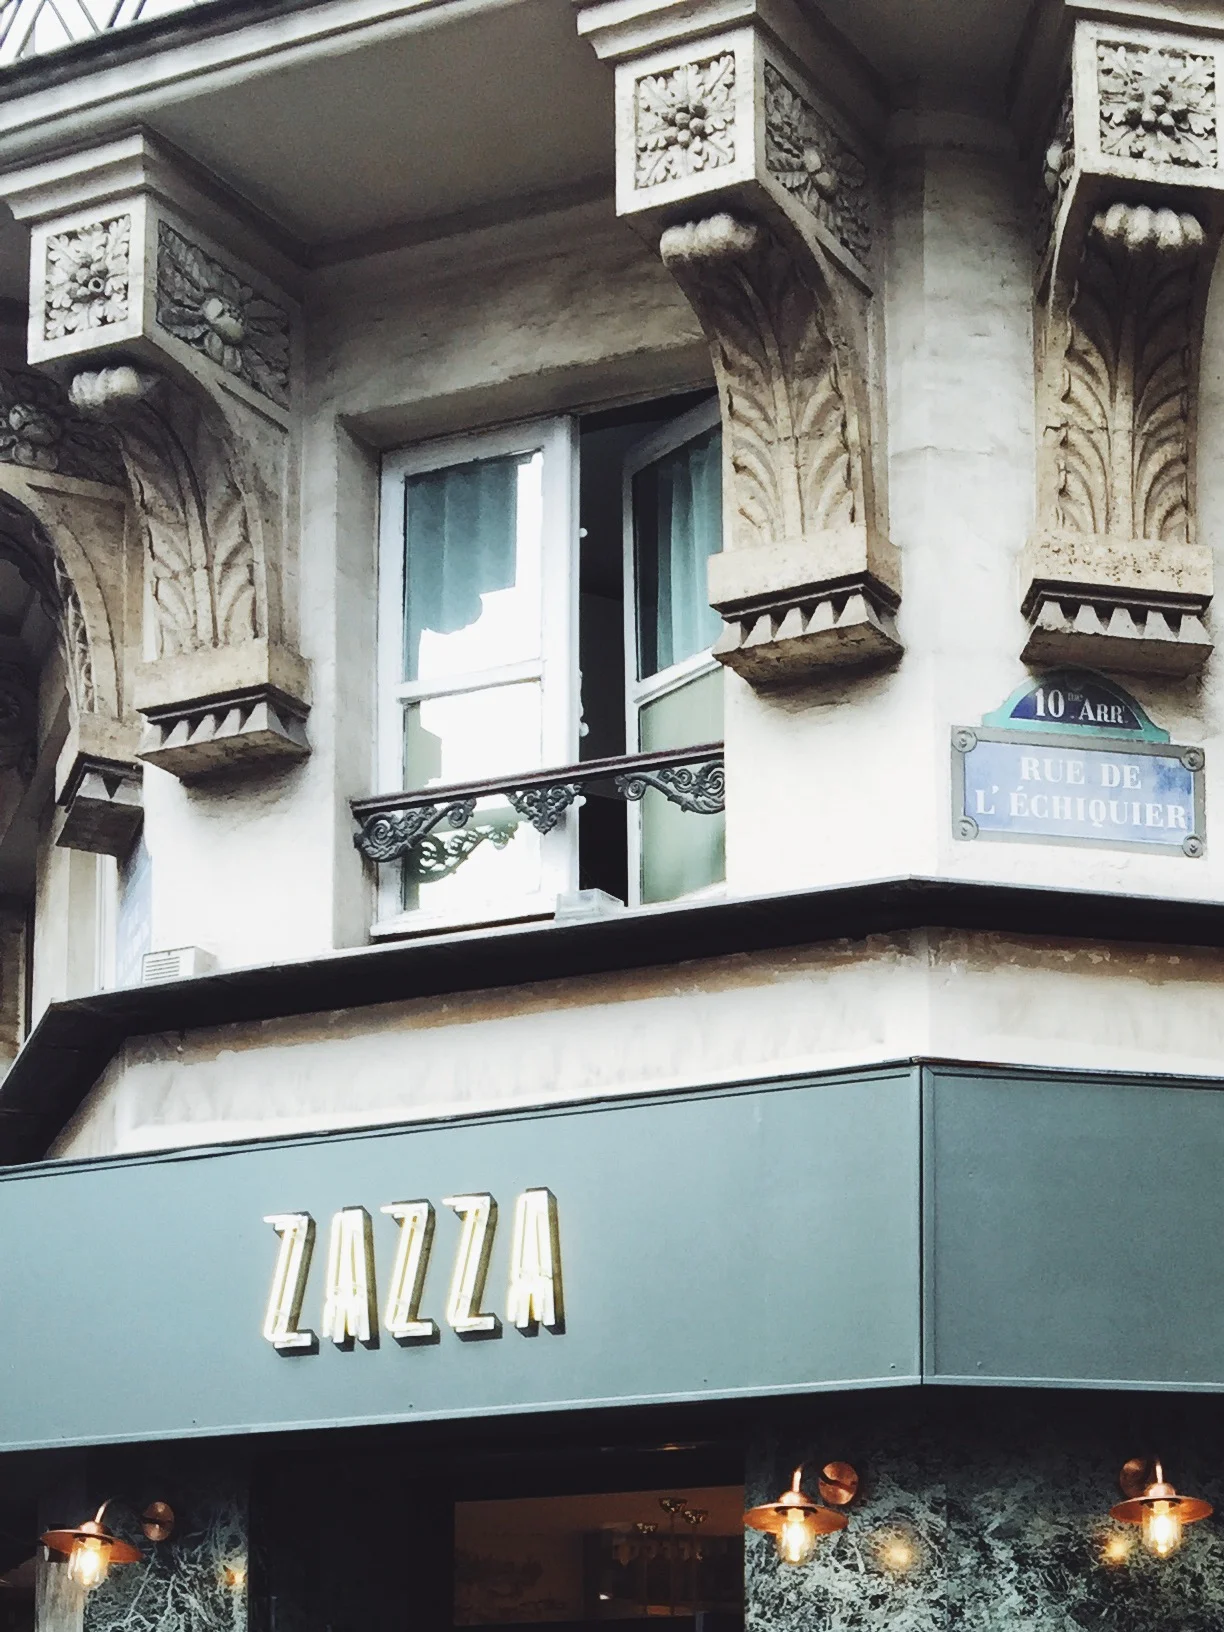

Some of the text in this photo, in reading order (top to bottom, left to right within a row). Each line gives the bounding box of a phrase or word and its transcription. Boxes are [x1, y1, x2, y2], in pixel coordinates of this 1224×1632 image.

[1020, 757, 1142, 790] RUE DE
[262, 1187, 566, 1357] ZAZZA
